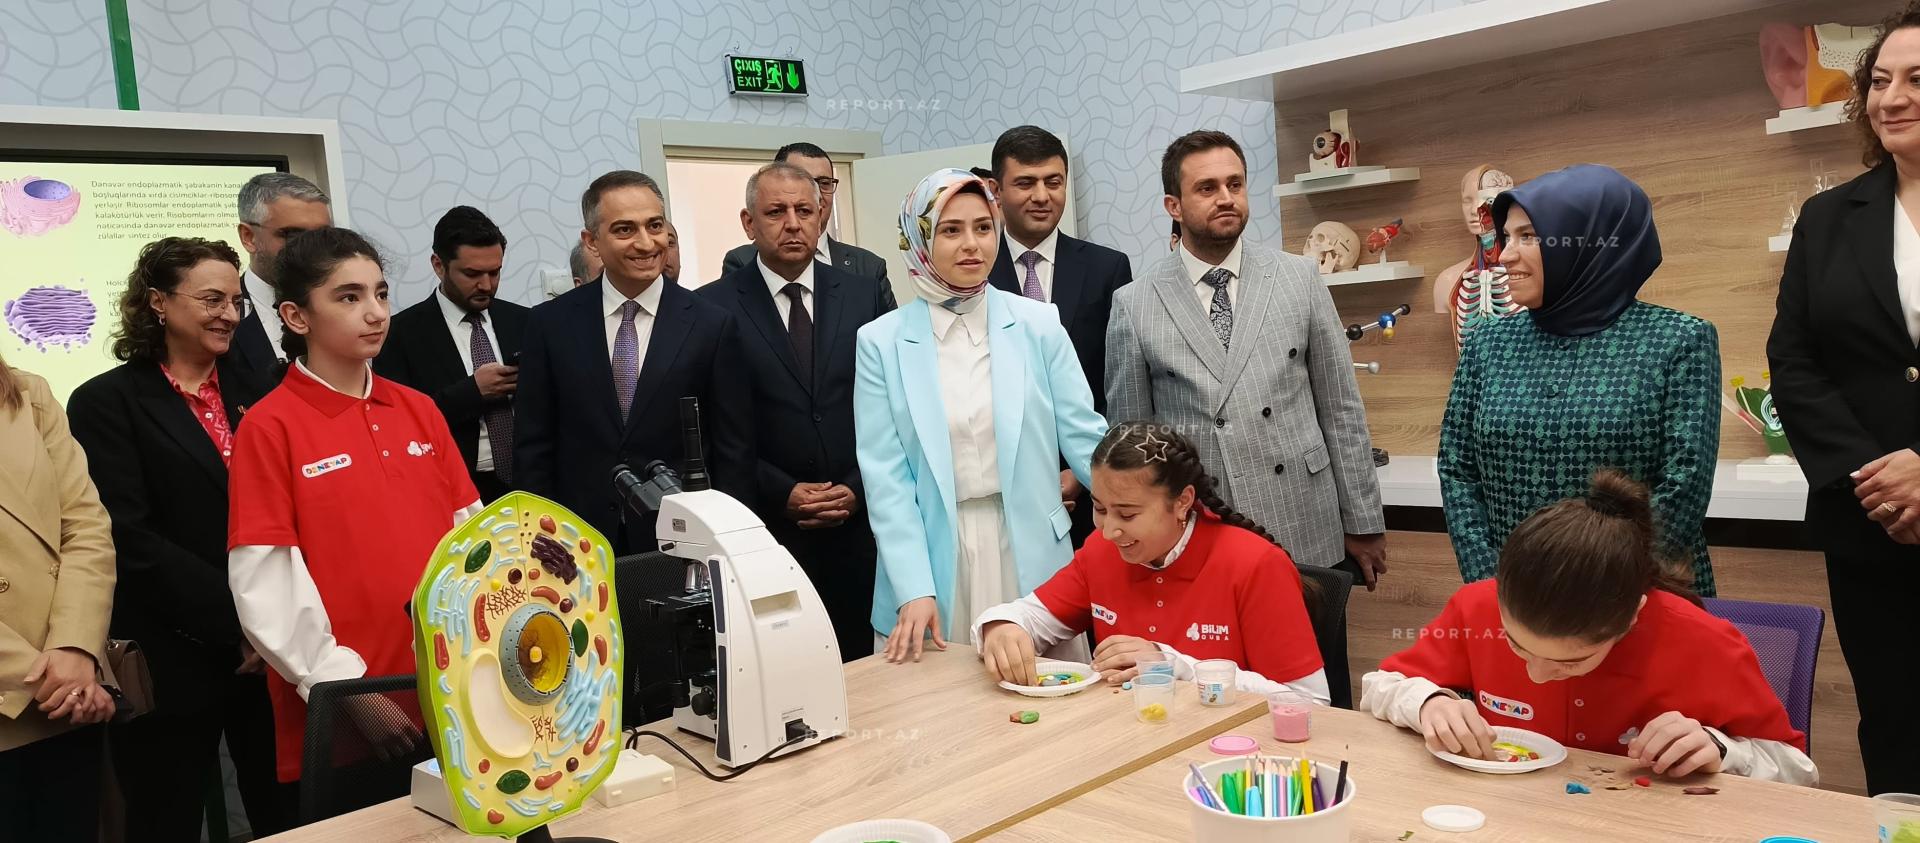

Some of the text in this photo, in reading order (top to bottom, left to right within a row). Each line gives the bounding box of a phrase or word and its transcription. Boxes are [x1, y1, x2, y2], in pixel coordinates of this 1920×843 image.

[734, 58, 762, 76] ÇIXIŞ
[737, 76, 763, 88] EXIT
[305, 457, 348, 475] DENEYAP
[1480, 694, 1531, 717] DENEYAP
